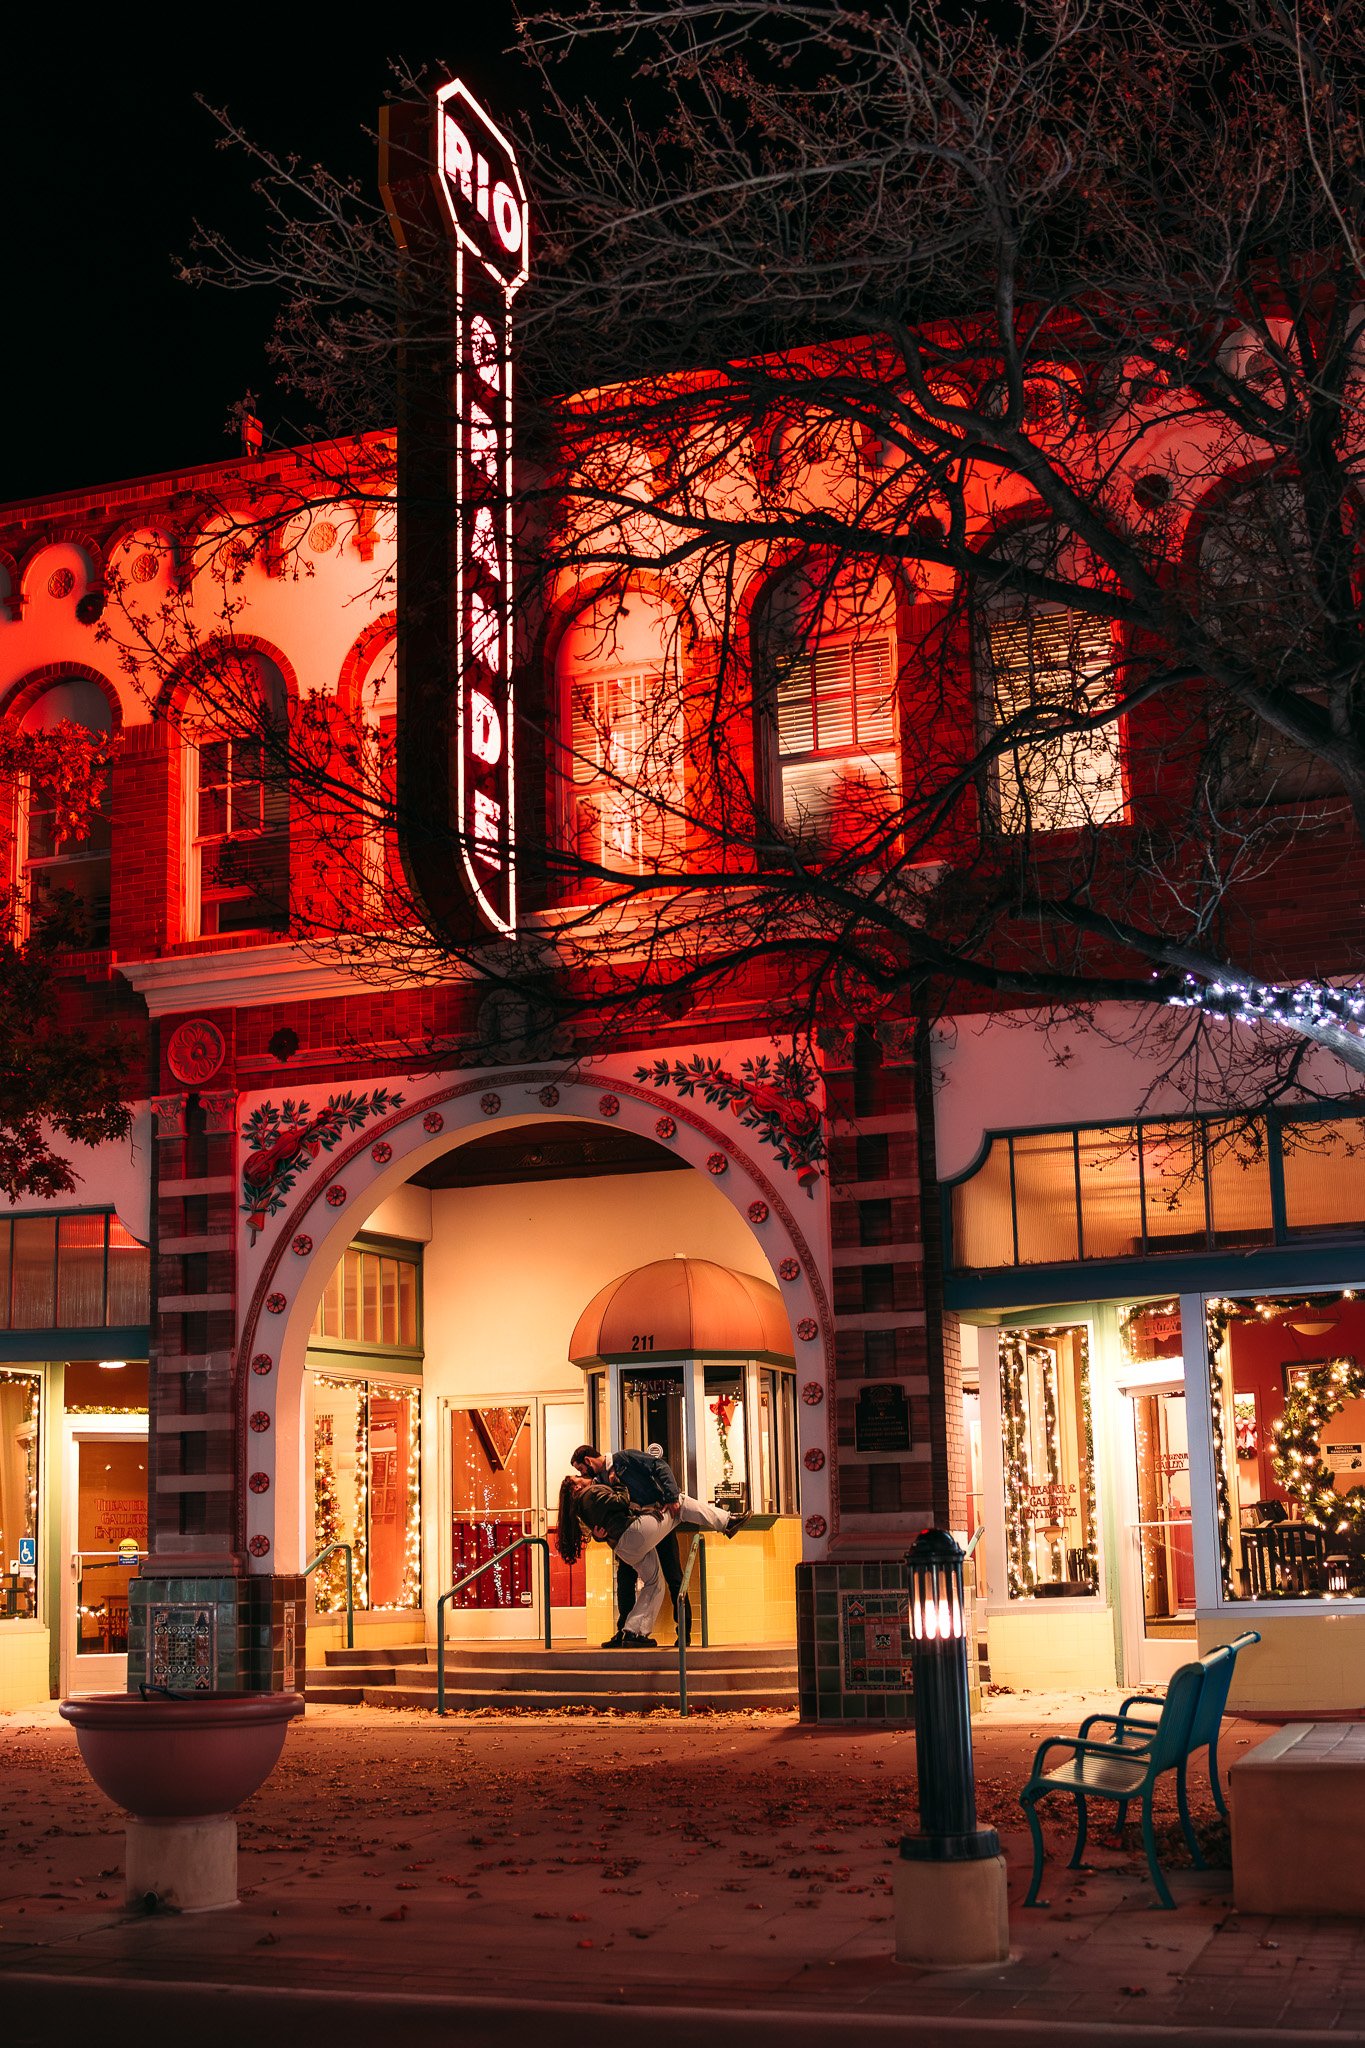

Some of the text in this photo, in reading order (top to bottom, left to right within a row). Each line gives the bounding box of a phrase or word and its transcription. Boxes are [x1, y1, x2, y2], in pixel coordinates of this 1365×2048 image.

[445, 114, 522, 253] RIO
[470, 314, 502, 872] GRANDE
[631, 1335, 654, 1351] 211
[1068, 1483, 1077, 1494] &
[1029, 1495, 1071, 1507] GALLERY
[1023, 1507, 1077, 1519] ENTRANCE
